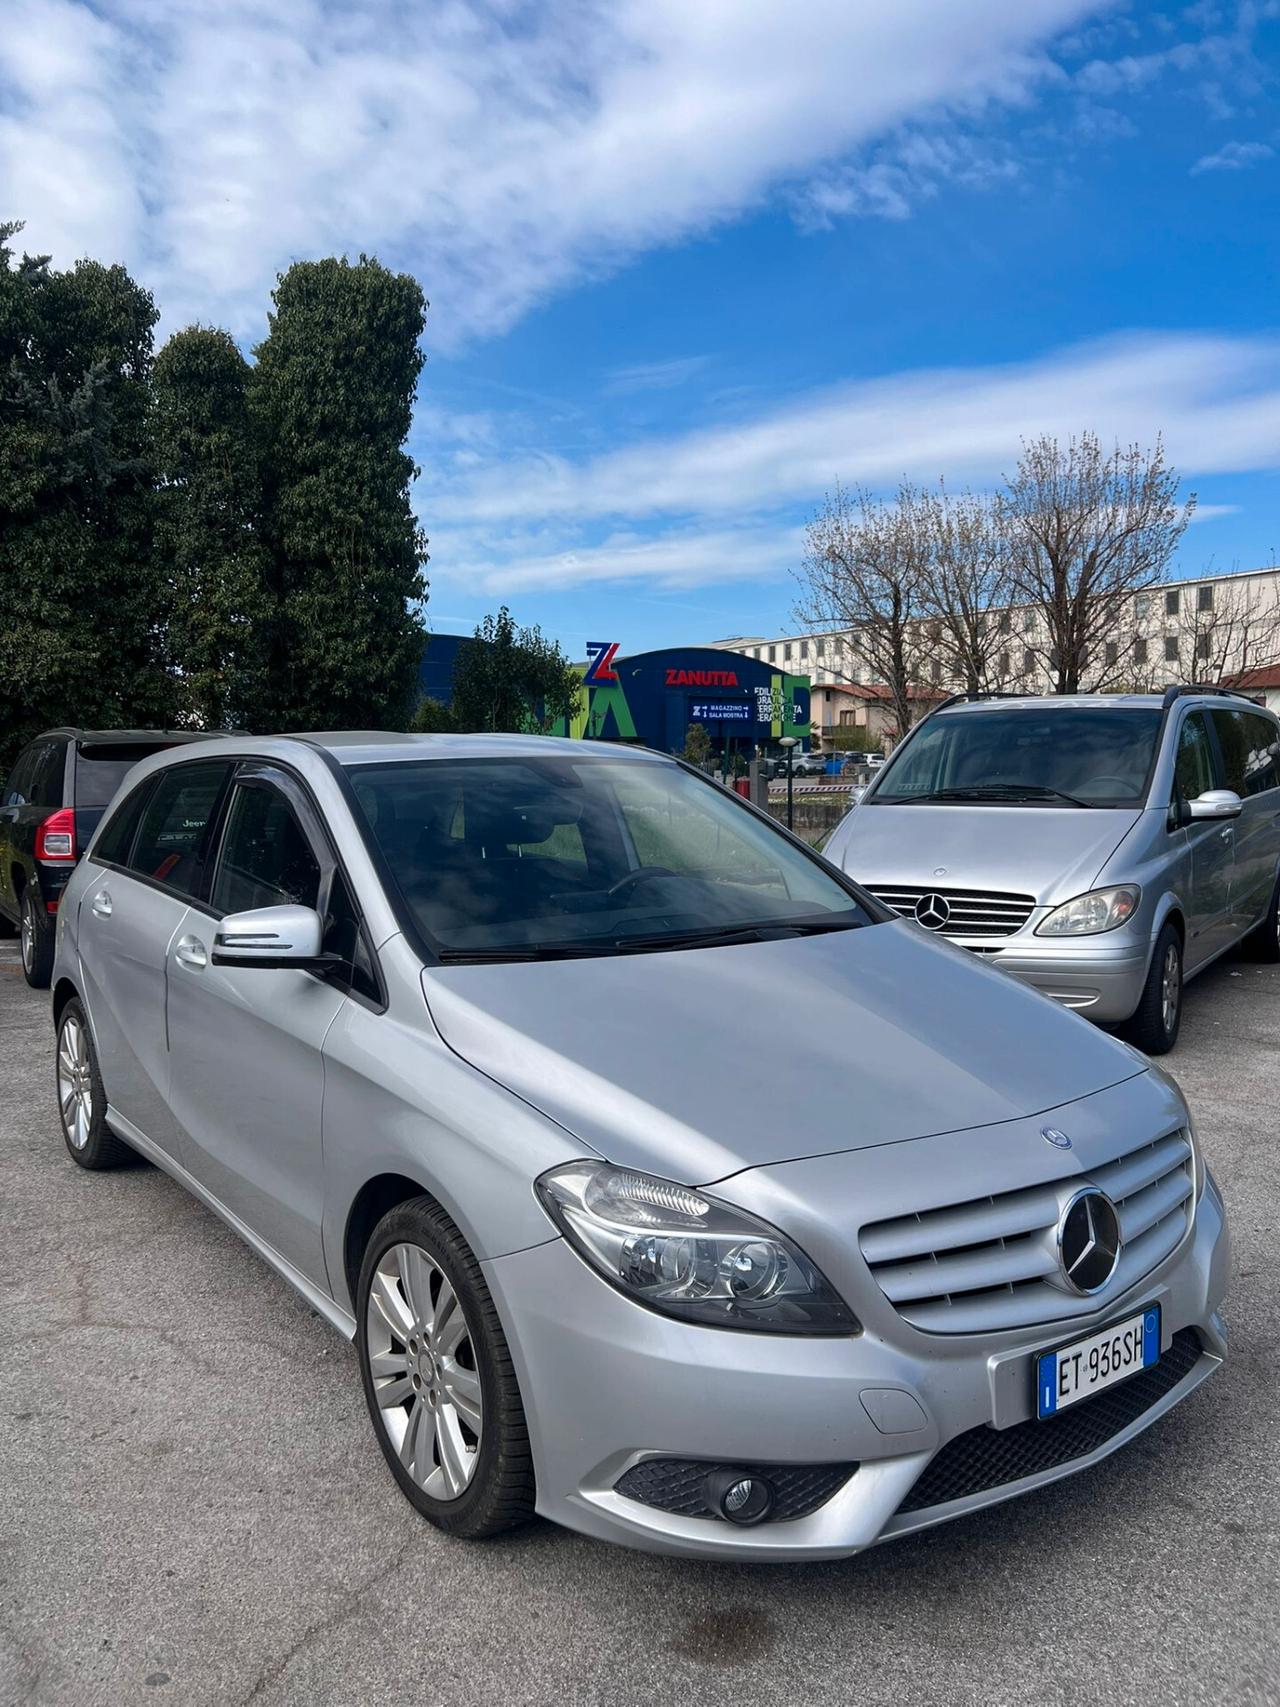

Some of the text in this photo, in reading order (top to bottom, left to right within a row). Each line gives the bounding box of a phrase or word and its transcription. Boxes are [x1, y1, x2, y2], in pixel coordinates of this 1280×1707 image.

[665, 669, 738, 686] ZANUTTA
[757, 705, 802, 714] ERRAMENTA
[1059, 1325, 1144, 1397] ET 936SH
